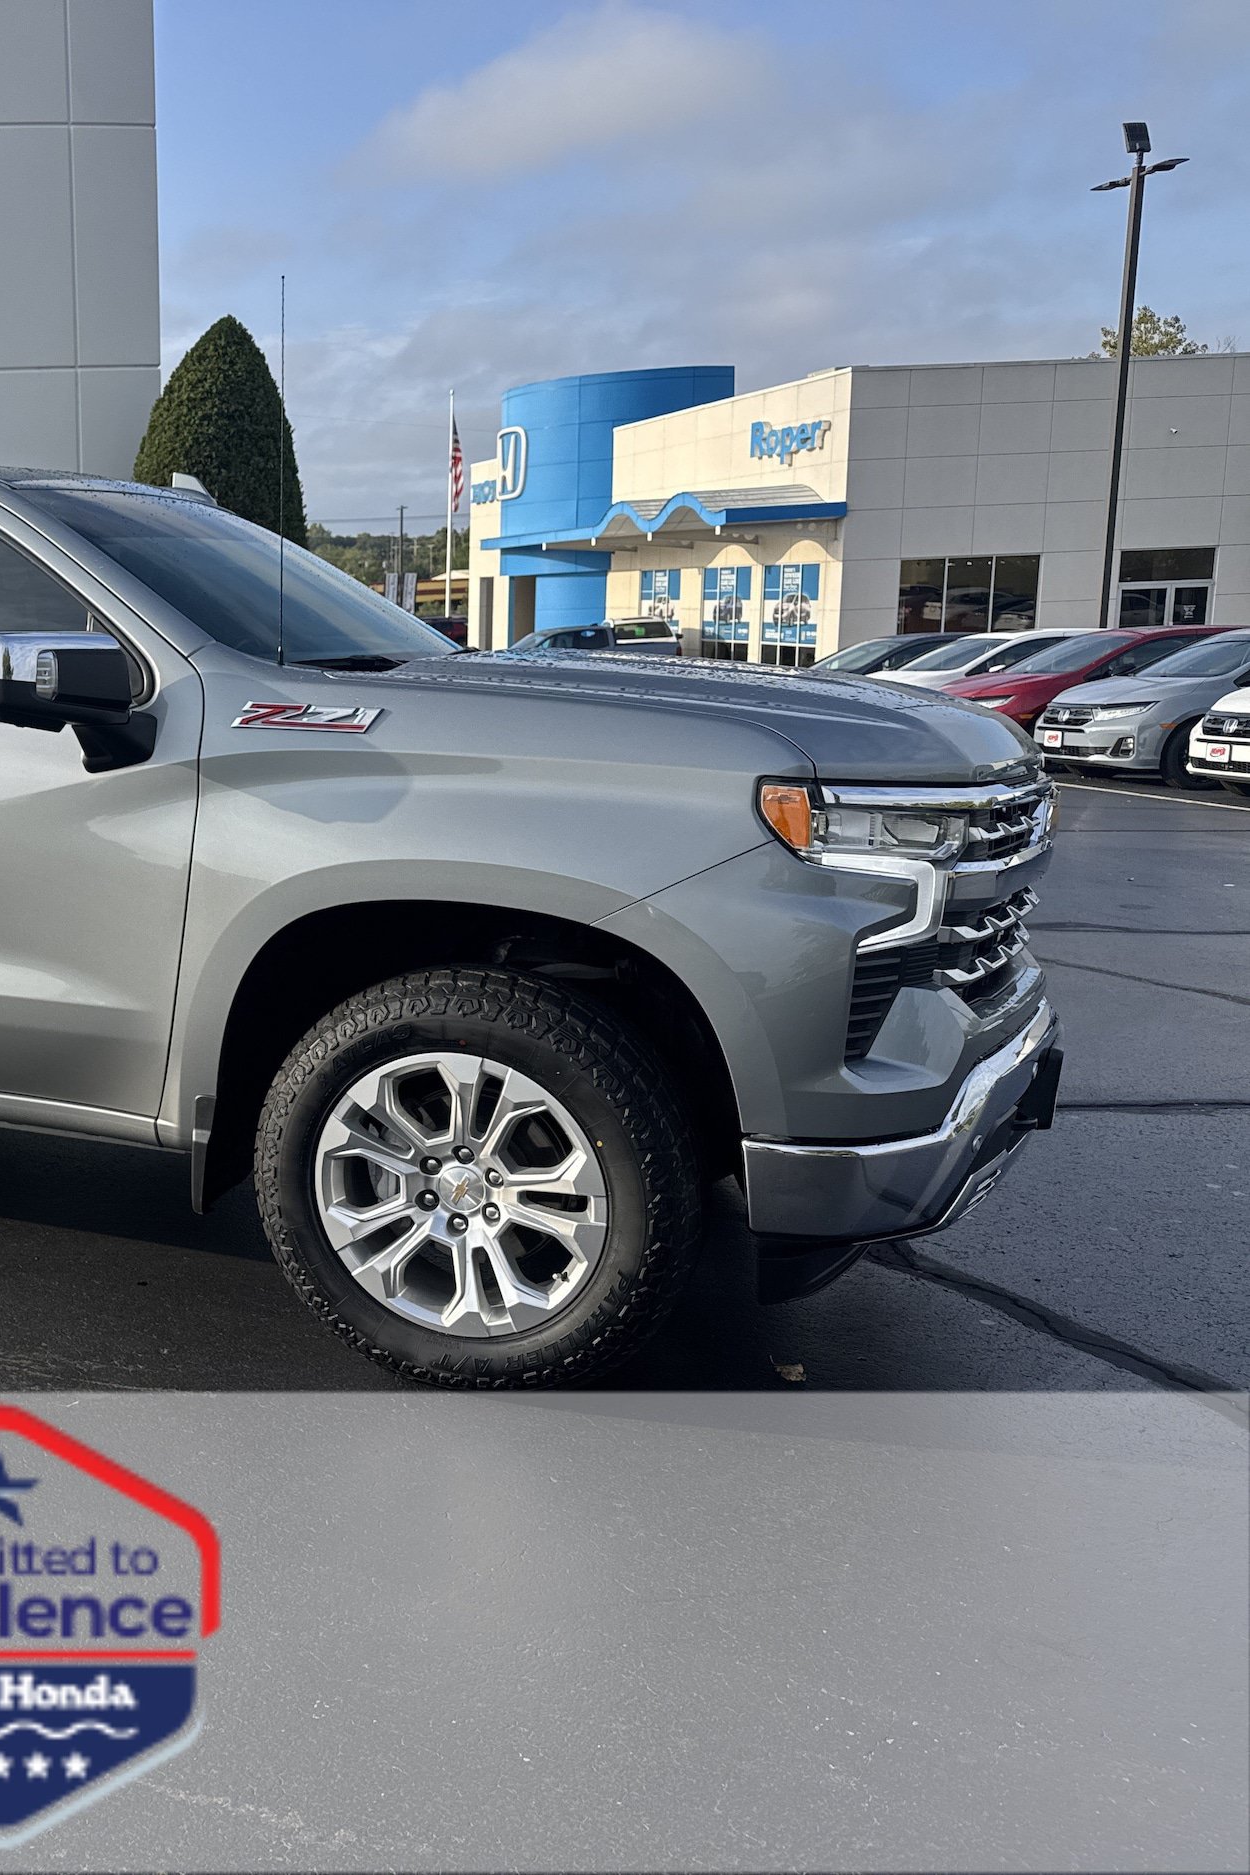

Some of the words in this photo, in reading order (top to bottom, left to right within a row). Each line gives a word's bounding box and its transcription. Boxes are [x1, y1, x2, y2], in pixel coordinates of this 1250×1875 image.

[749, 419, 828, 467] Roper
[230, 700, 385, 734] Z71
[332, 1023, 413, 1077] ATLAS
